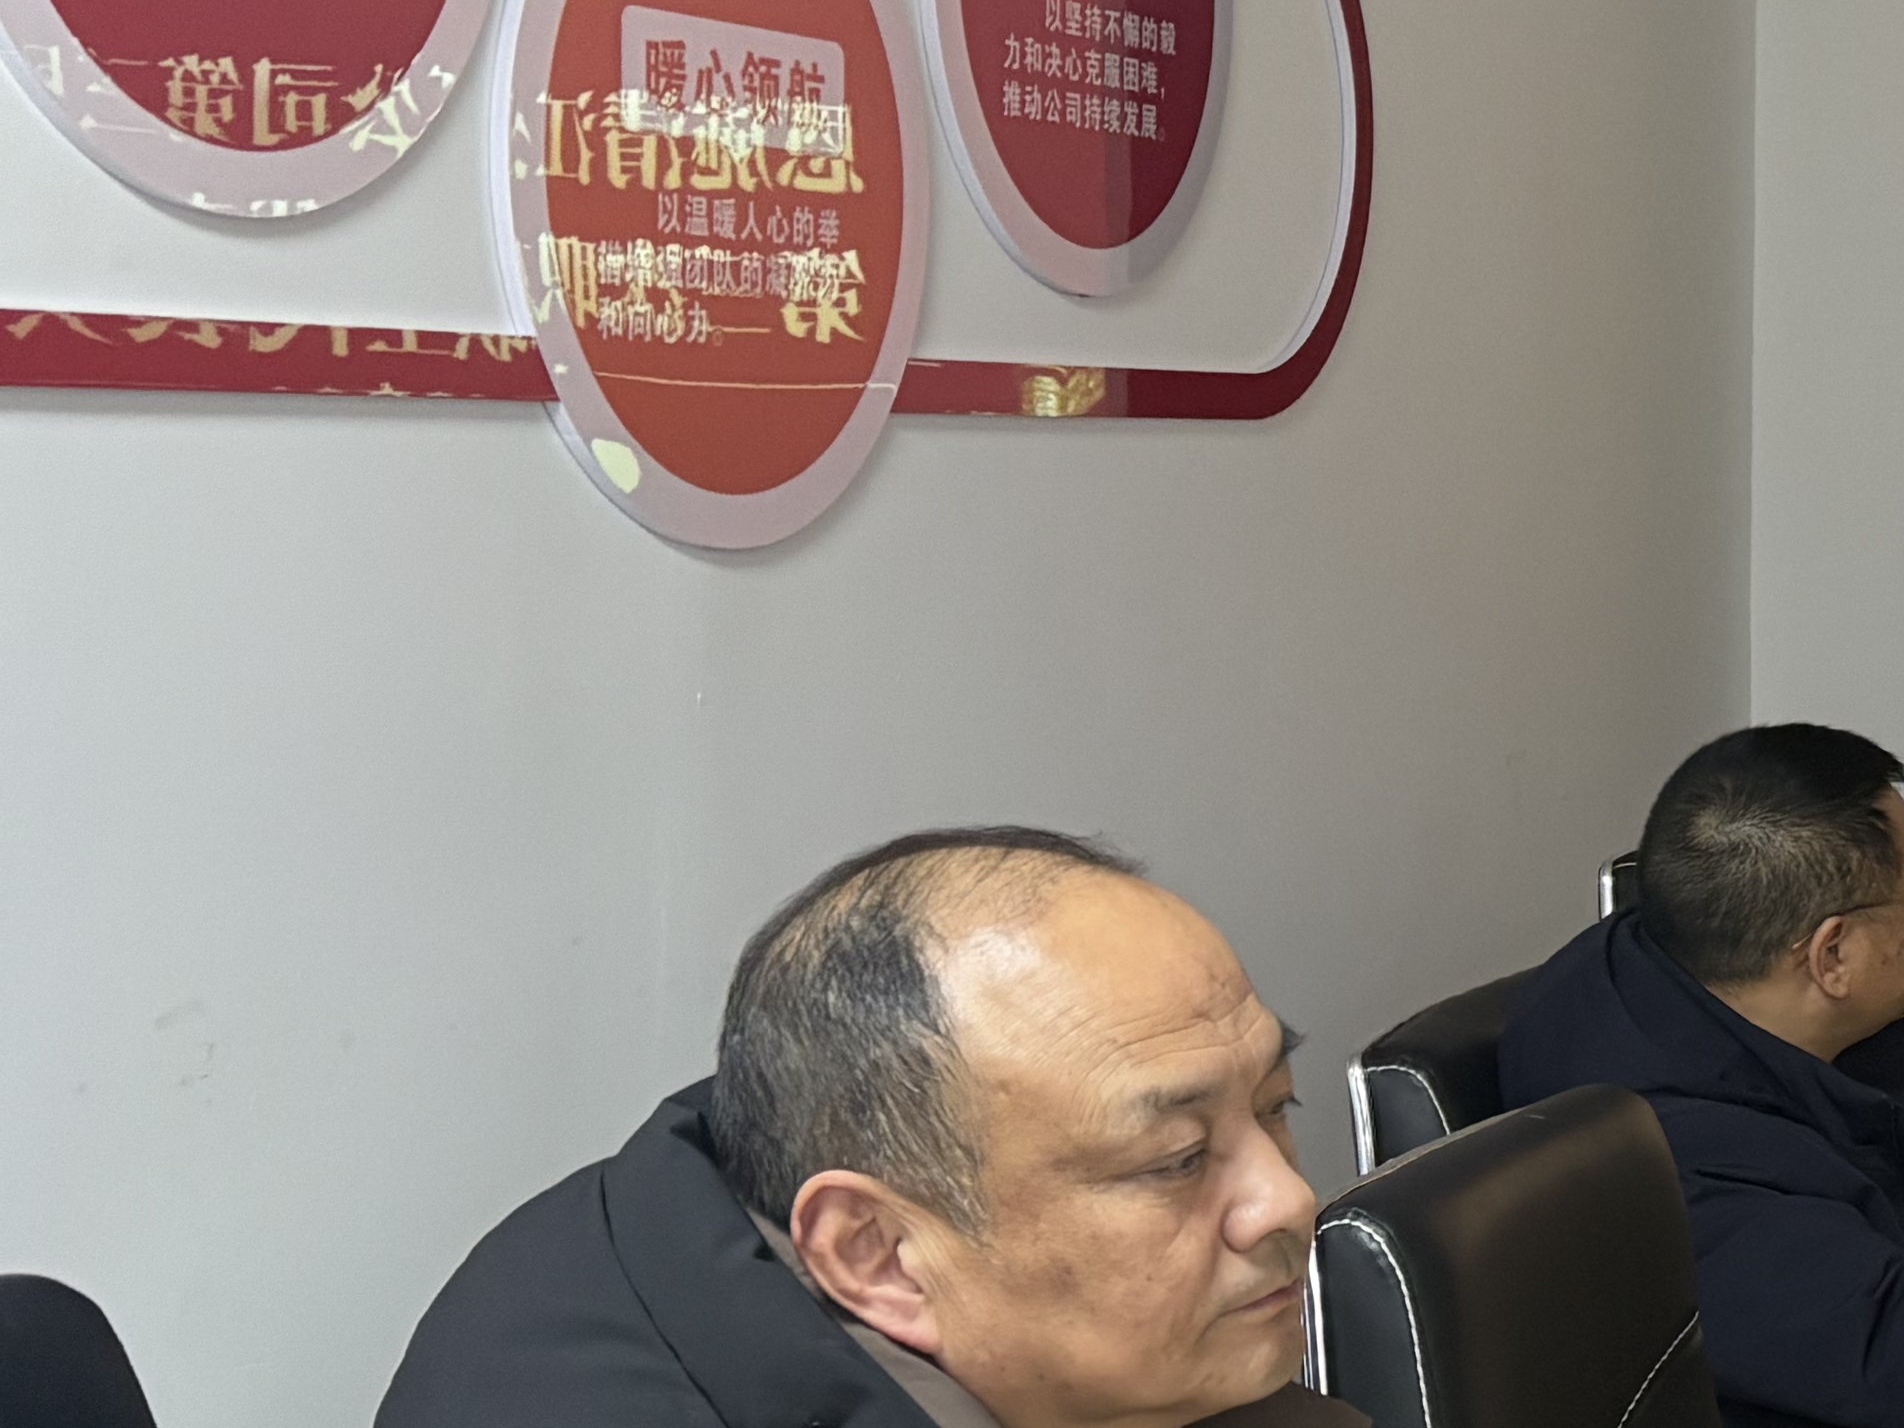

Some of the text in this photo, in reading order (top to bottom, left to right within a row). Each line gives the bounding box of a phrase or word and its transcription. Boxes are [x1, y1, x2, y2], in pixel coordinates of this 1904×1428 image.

[645, 39, 826, 132] 暖心领航
[658, 193, 841, 248] 以温暖人心的举
